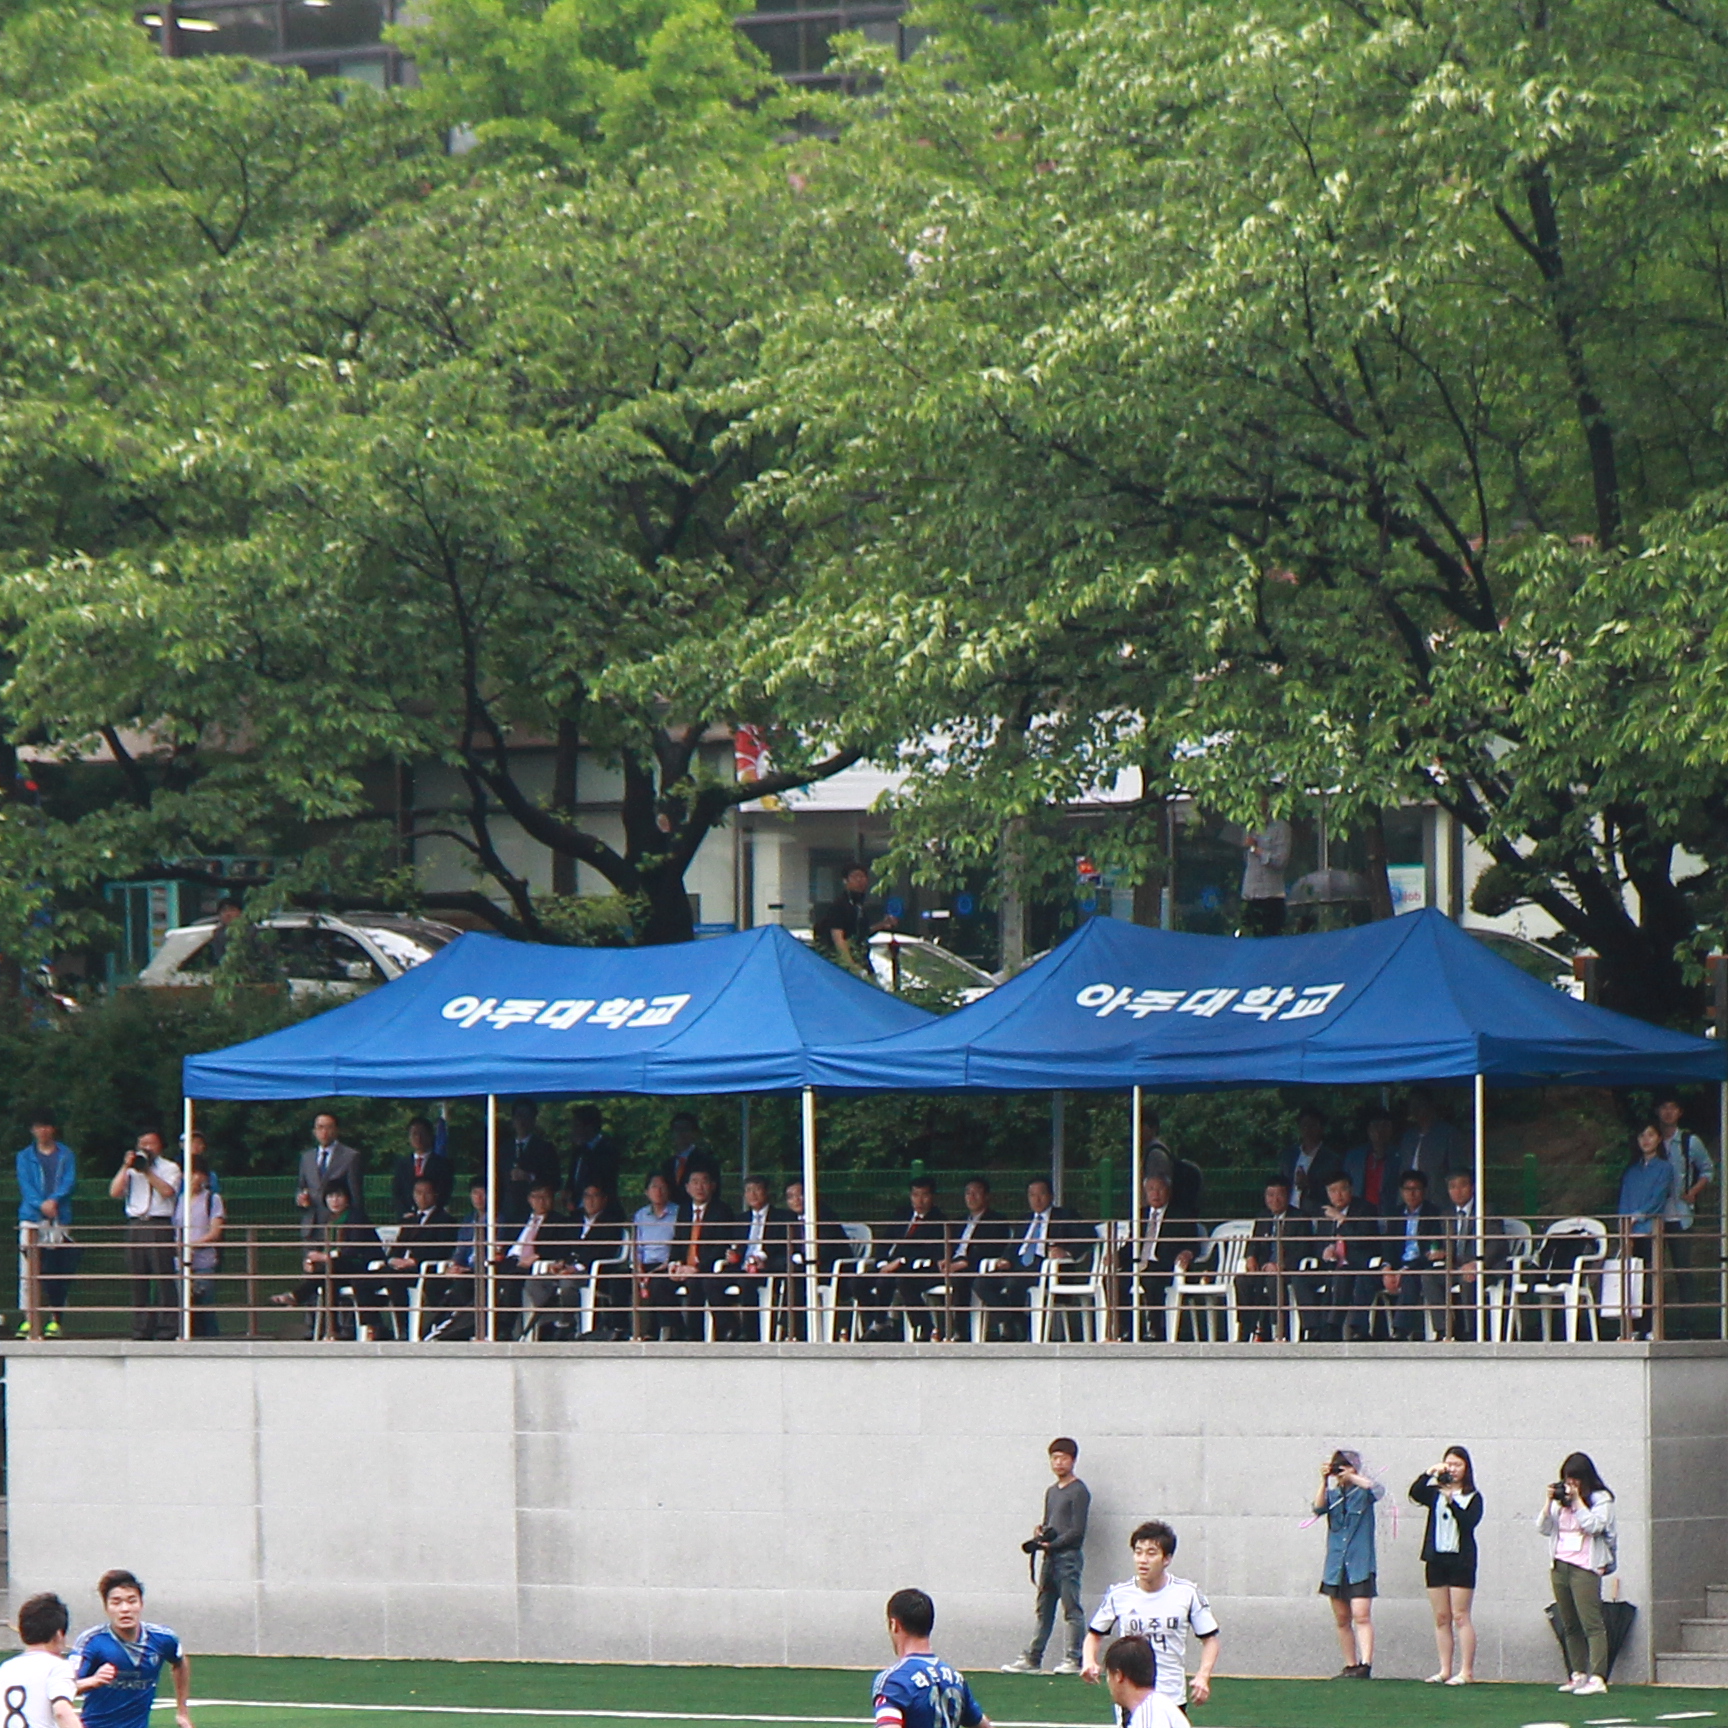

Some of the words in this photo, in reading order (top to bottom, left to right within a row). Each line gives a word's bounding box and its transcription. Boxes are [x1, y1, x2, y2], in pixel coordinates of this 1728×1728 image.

[441, 993, 692, 1030] 아주대학교
[1076, 983, 1345, 1021] 아주대학교
[1129, 1617, 1179, 1634] 아주대
